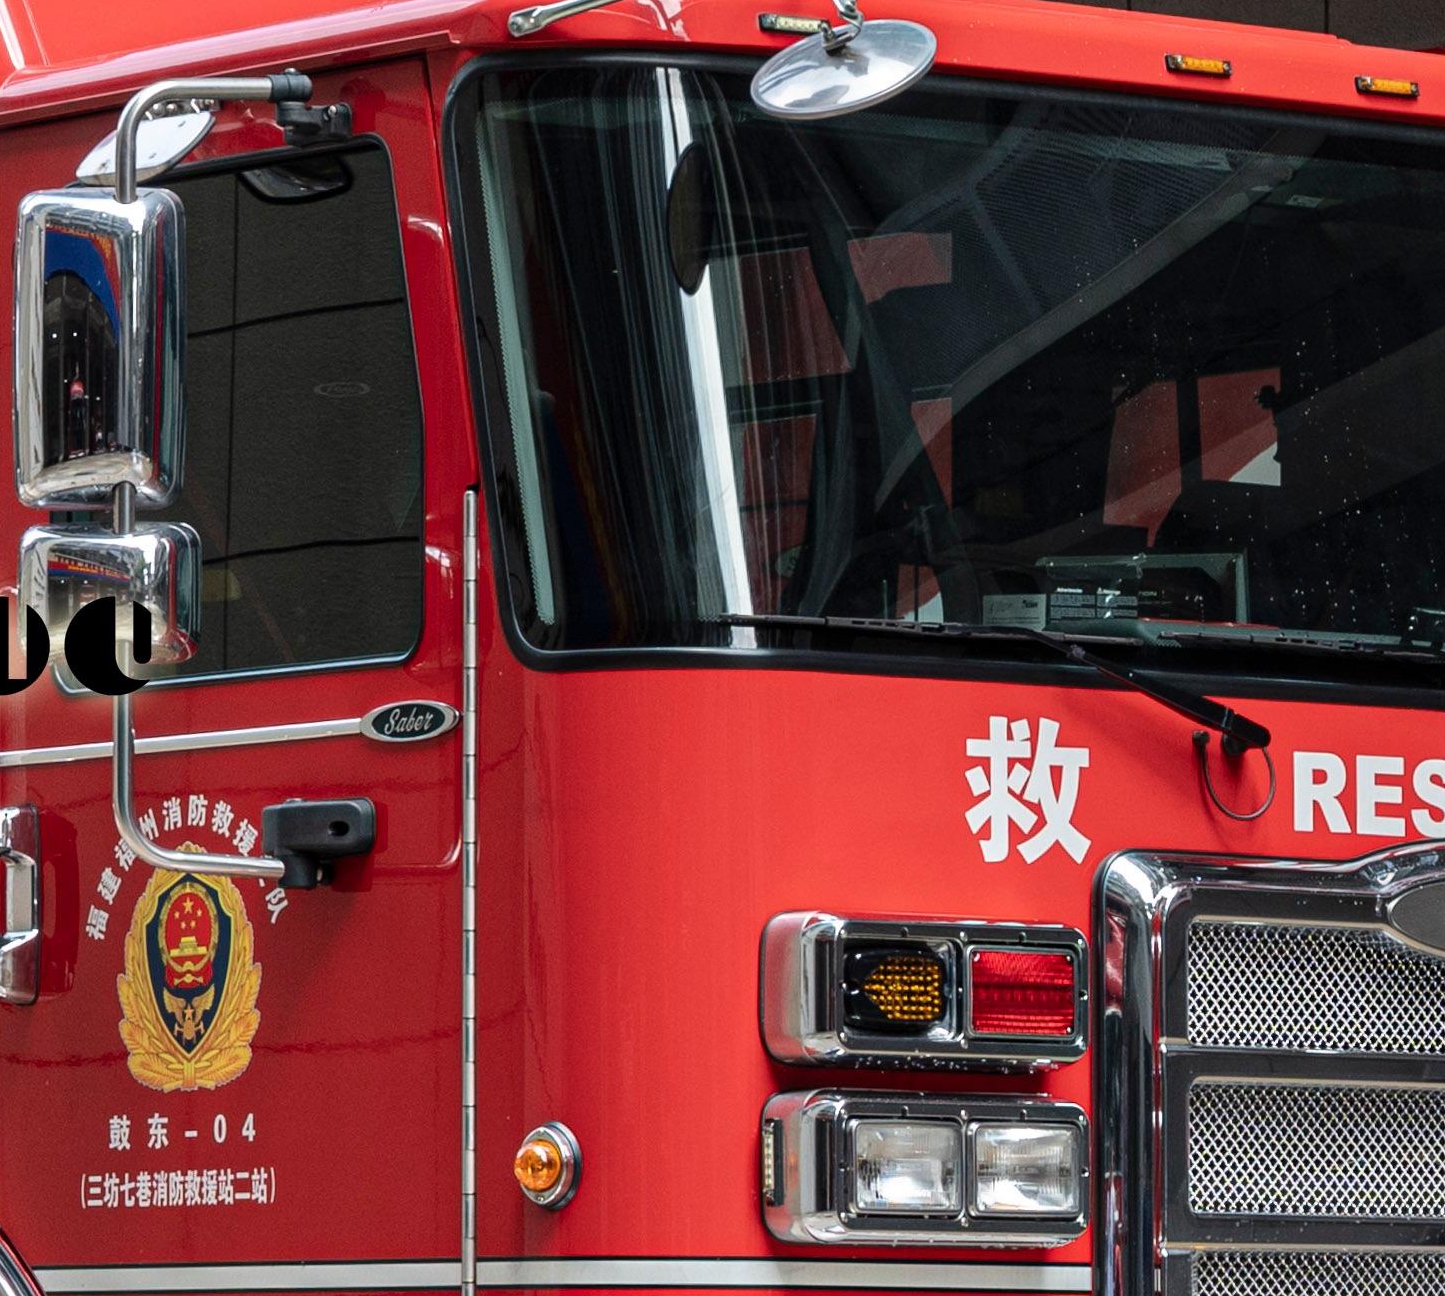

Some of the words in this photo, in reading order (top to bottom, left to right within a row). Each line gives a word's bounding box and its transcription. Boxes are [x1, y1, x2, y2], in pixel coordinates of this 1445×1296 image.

[383, 707, 434, 735] Saber
[964, 716, 1091, 864] 救
[86, 794, 289, 941] 福建福州消防救援队
[81, 1167, 276, 1209] (三坊七巷消防救援站二站)
